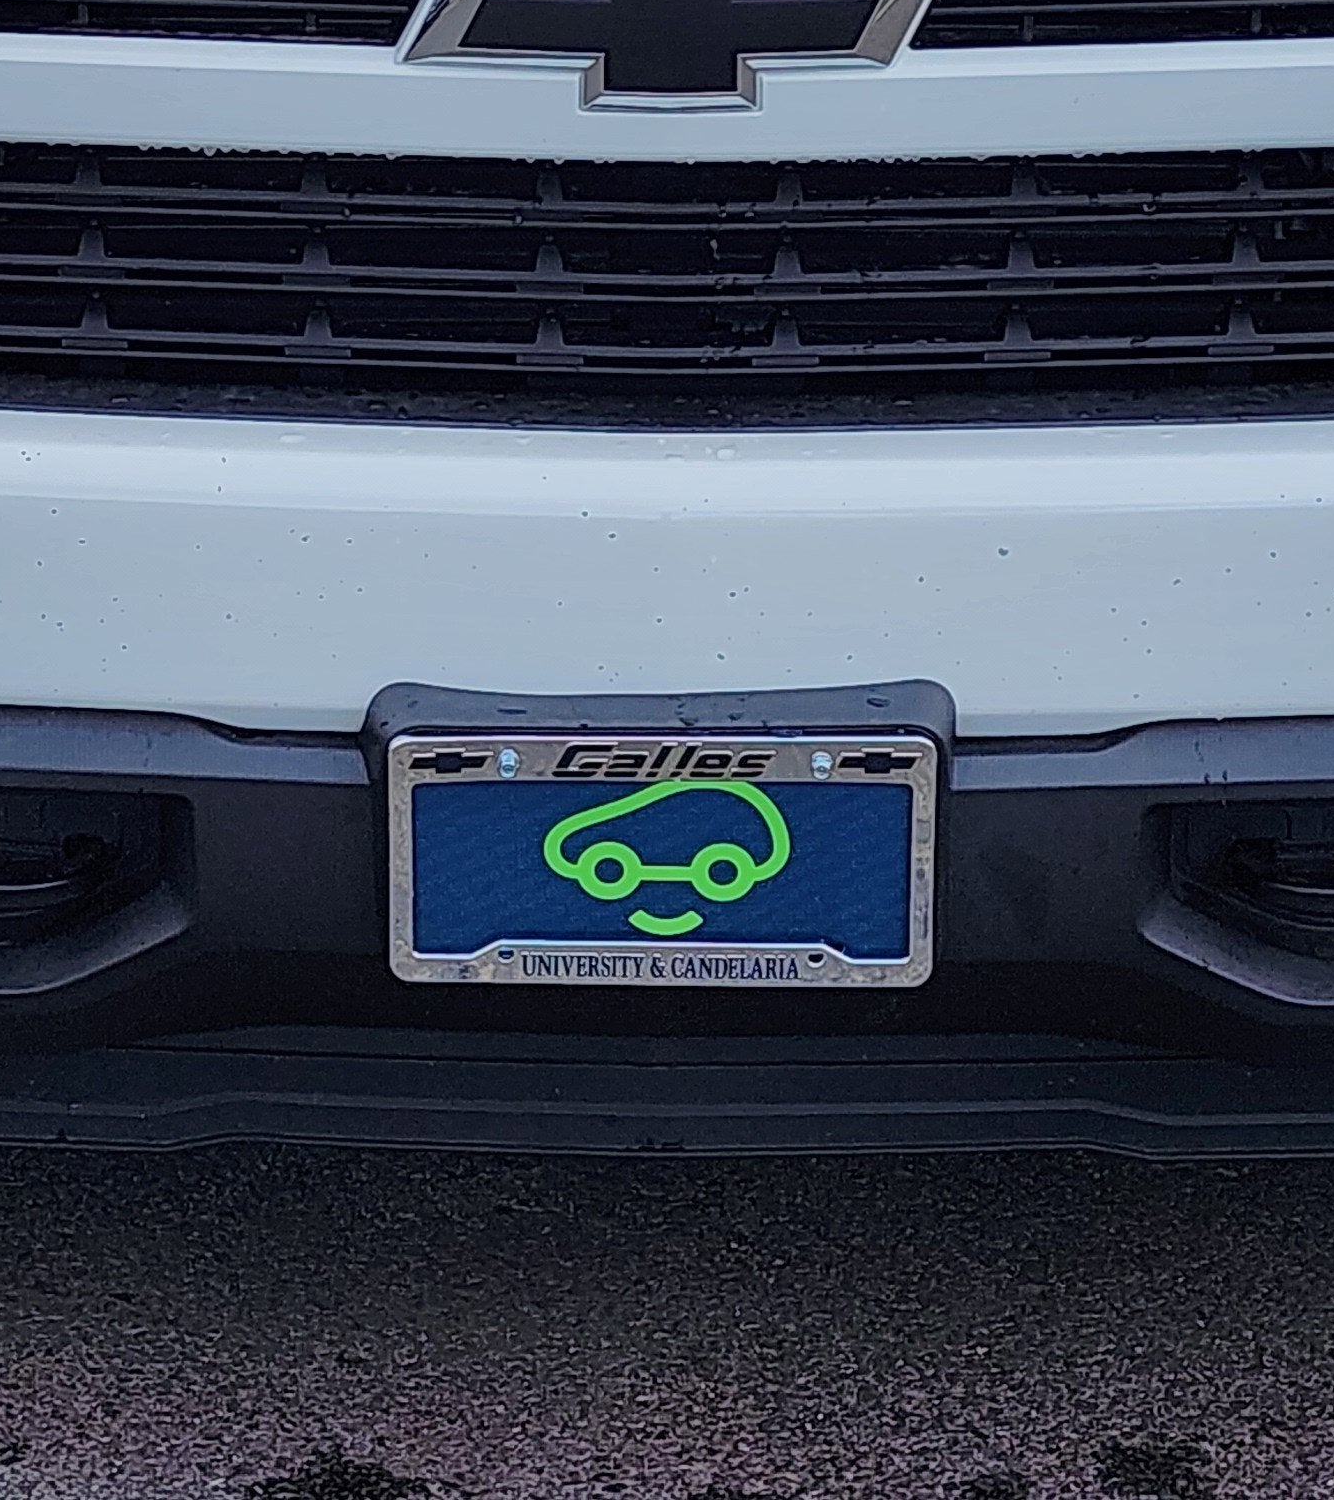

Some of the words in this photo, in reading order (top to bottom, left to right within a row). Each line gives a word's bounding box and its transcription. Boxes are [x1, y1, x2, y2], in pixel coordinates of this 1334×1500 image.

[552, 741, 777, 778] Galles
[520, 952, 646, 978] UNIVERSITY
[650, 953, 667, 978] &
[671, 954, 799, 981] CANDELARIA
